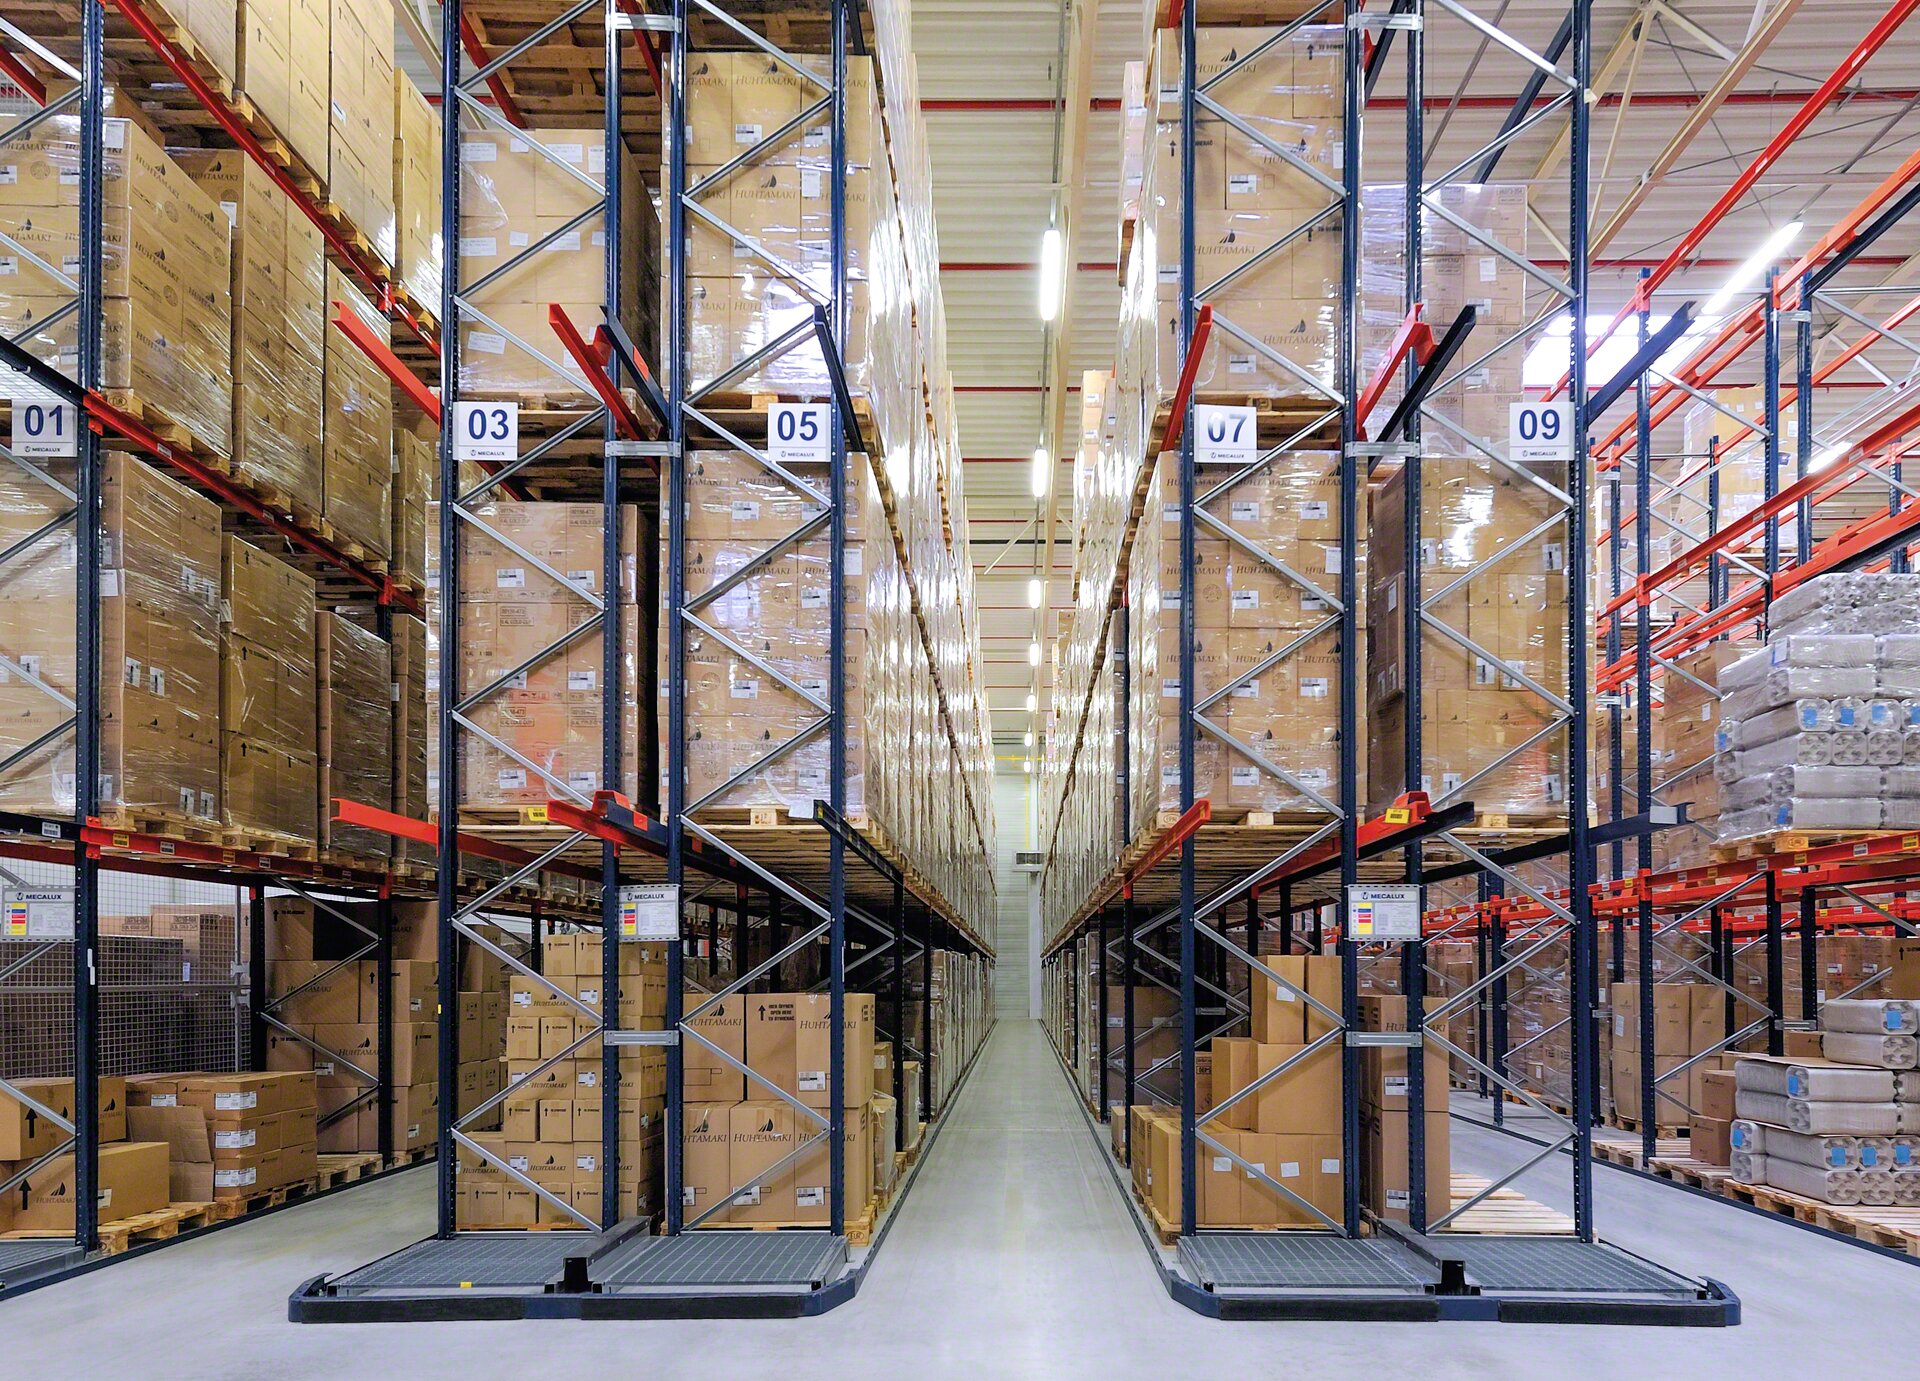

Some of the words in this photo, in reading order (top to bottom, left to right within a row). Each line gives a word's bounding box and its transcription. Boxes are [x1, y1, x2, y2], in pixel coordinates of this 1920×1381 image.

[735, 76, 798, 87] HUHTAMAKI
[735, 189, 798, 200] HUHTAMAKI
[1194, 245, 1255, 255] HUHTAMAKI
[25, 405, 62, 436] 01
[468, 409, 509, 440] 03
[777, 410, 818, 441] 05
[1519, 409, 1560, 440] 09
[1207, 412, 1247, 443] 07
[683, 1133, 727, 1143] HTAMAKI
[733, 1133, 792, 1143] HUHTAMAKI
[850, 1232, 862, 1240] EUR
